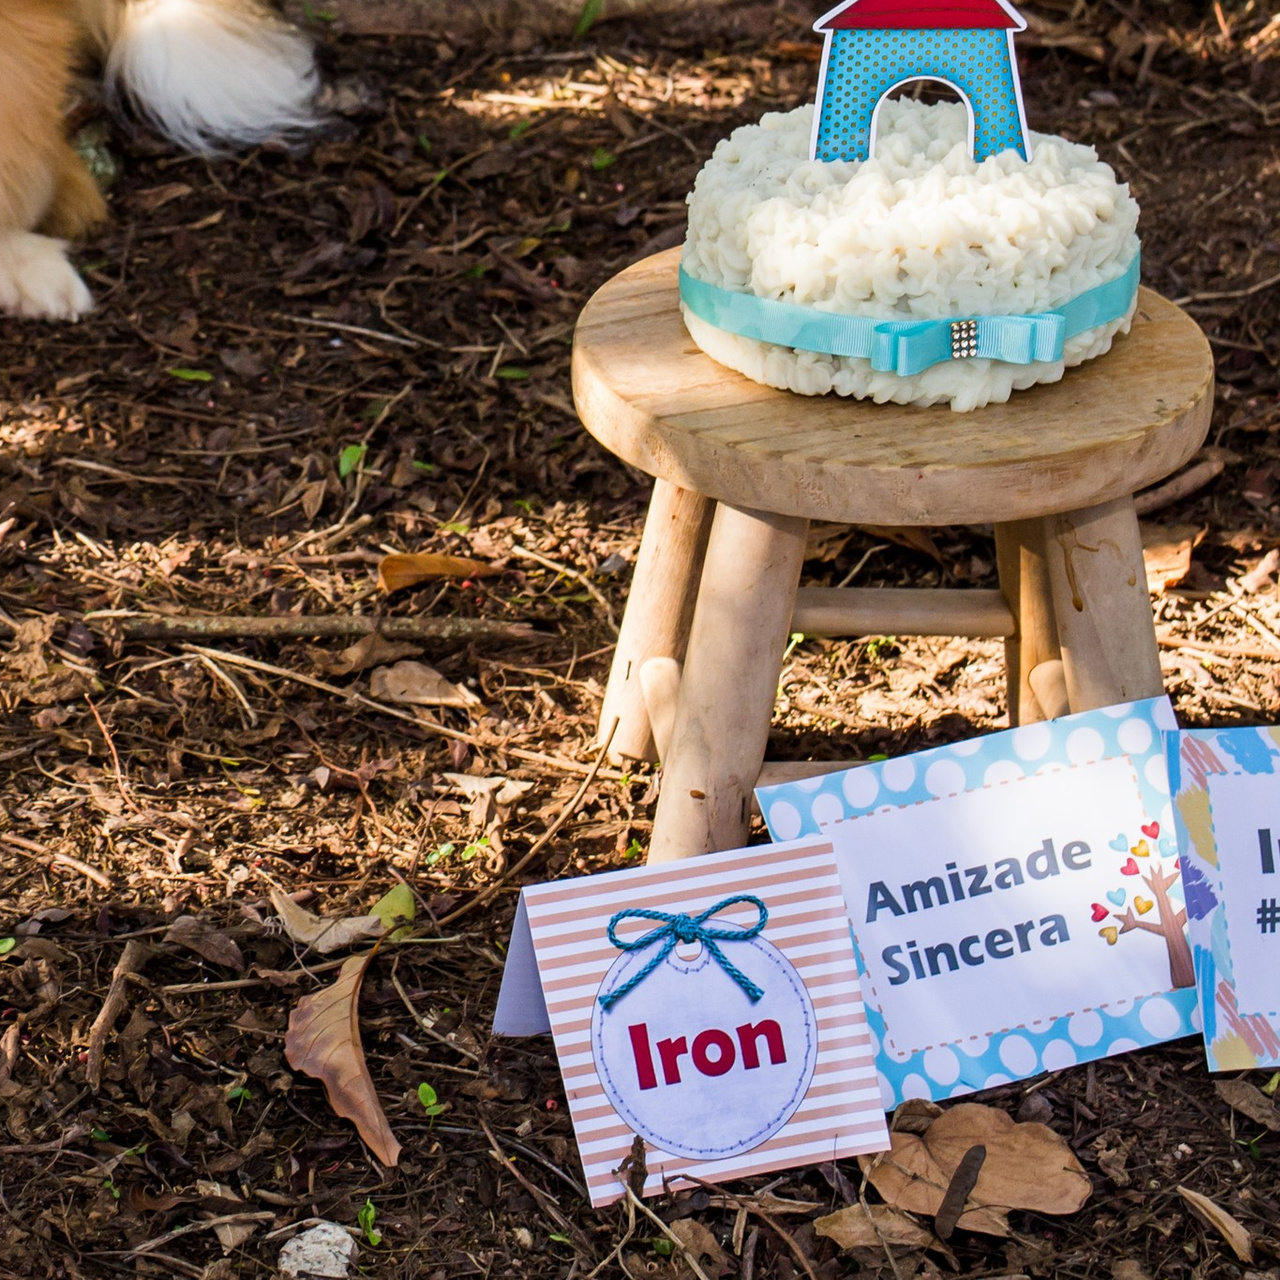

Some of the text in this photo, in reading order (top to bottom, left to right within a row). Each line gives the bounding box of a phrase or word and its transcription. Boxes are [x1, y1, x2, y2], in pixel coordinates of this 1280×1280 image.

[865, 836, 1093, 924] Amizade
[1257, 828, 1280, 874] I
[881, 913, 1072, 986] Sincera
[628, 1019, 787, 1091] Iron
